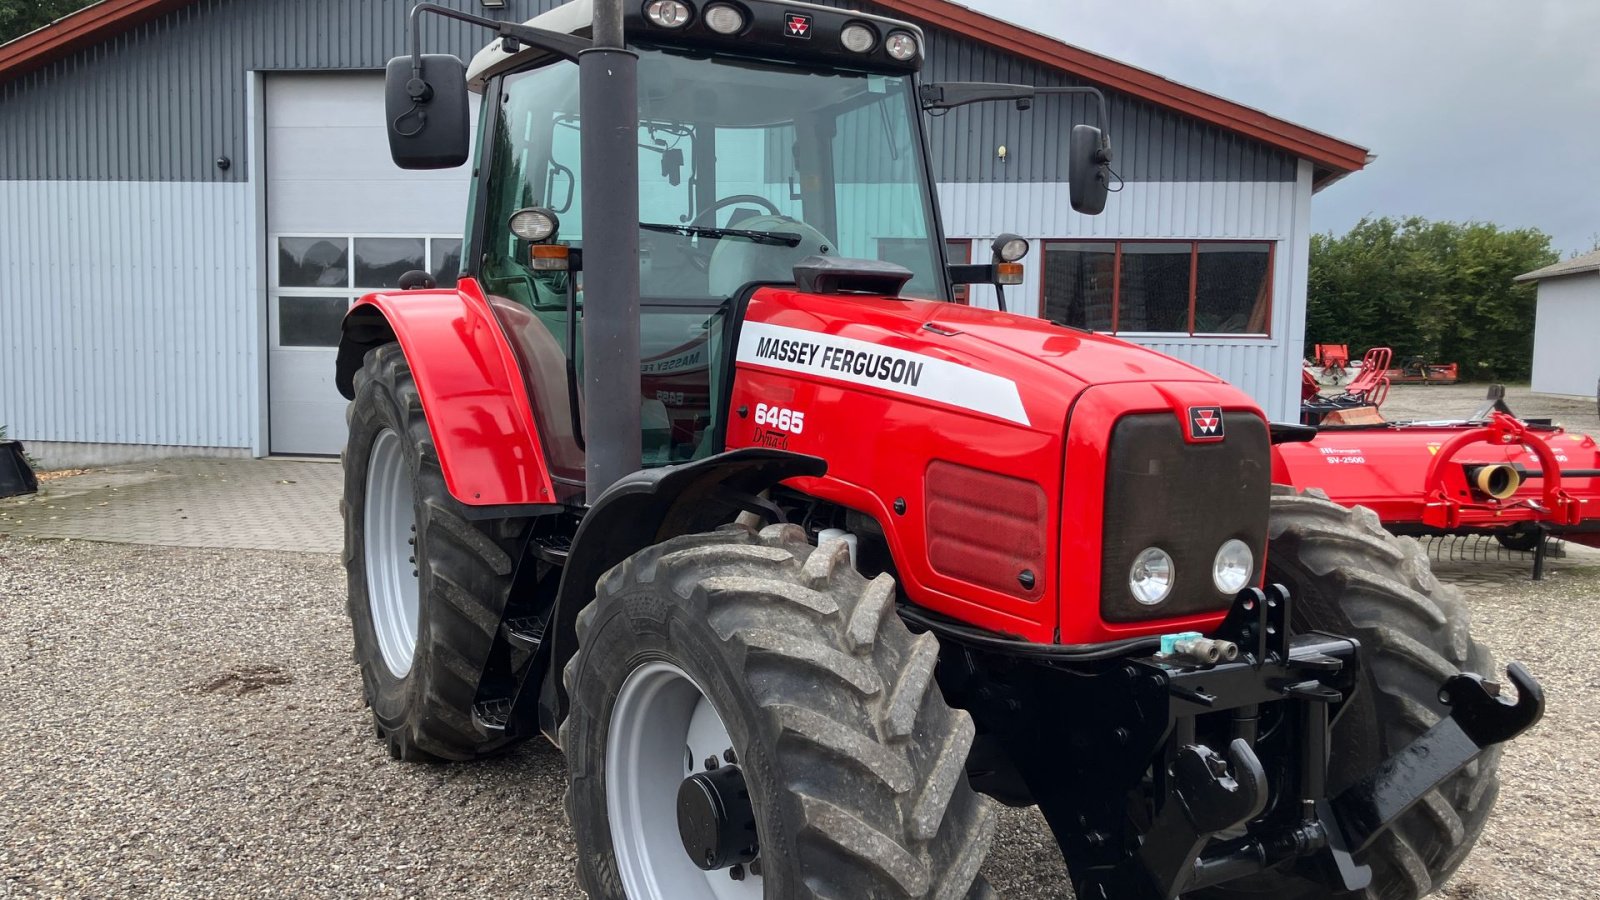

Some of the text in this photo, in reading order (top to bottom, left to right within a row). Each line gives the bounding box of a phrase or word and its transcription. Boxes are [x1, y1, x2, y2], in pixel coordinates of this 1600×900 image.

[756, 336, 924, 387] MASSEY FERGUSON
[754, 402, 805, 435] 6465
[1326, 456, 1366, 464] SV-2500
